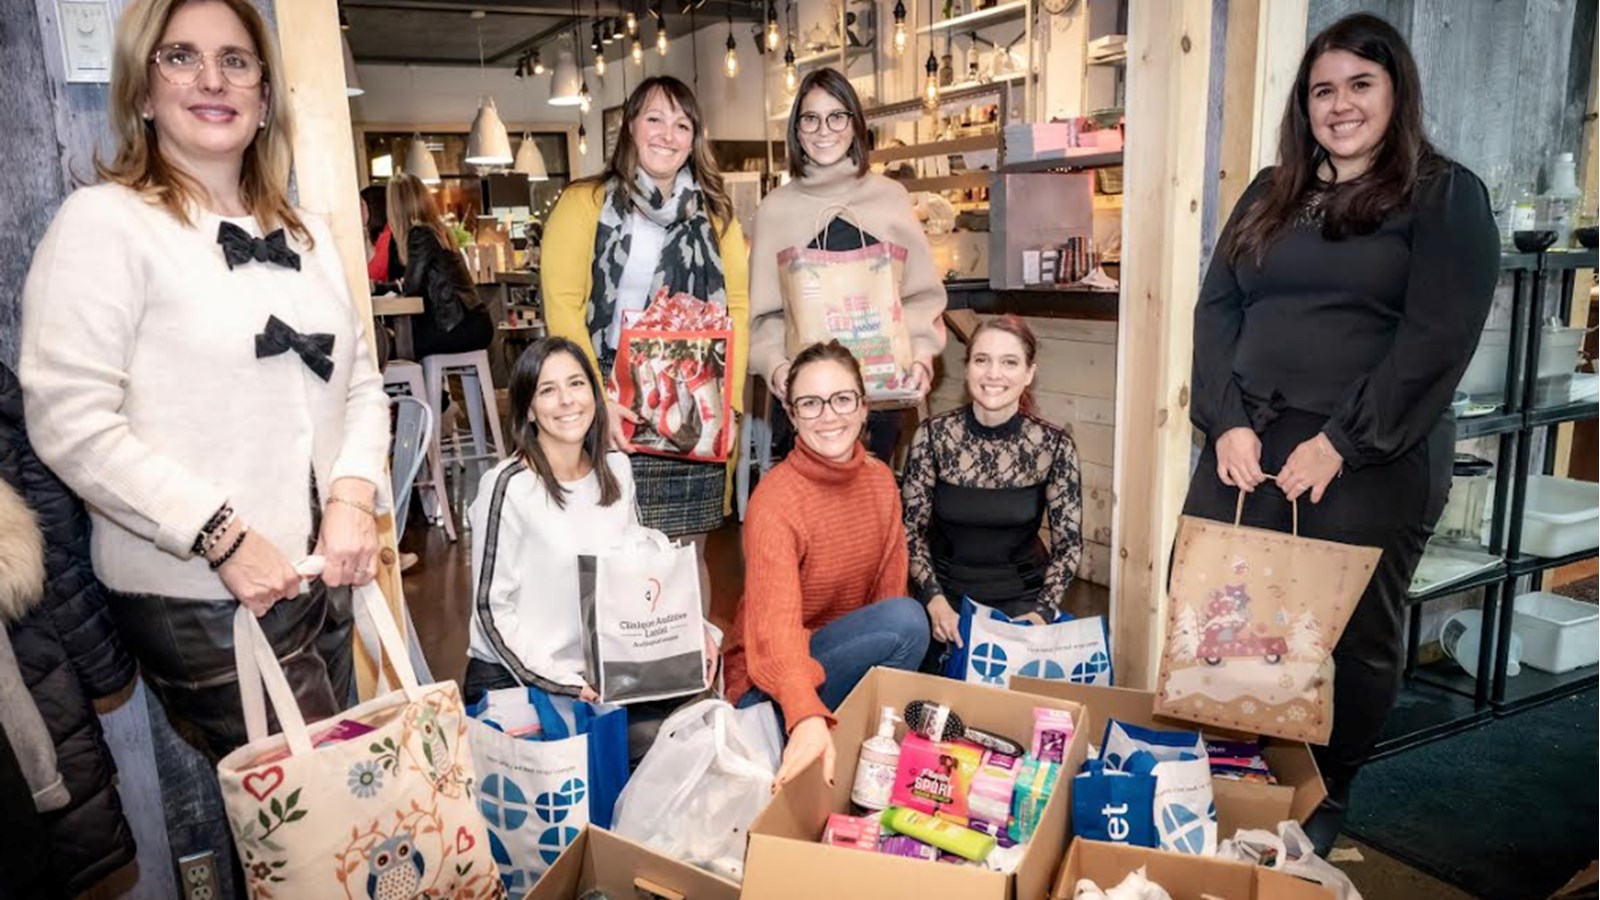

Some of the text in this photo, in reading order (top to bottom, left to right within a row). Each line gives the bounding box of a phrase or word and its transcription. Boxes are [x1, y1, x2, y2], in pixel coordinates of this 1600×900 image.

[619, 613, 687, 631] Clinique Auditive
[914, 777, 954, 797] SPORT
[1102, 803, 1129, 845] et
